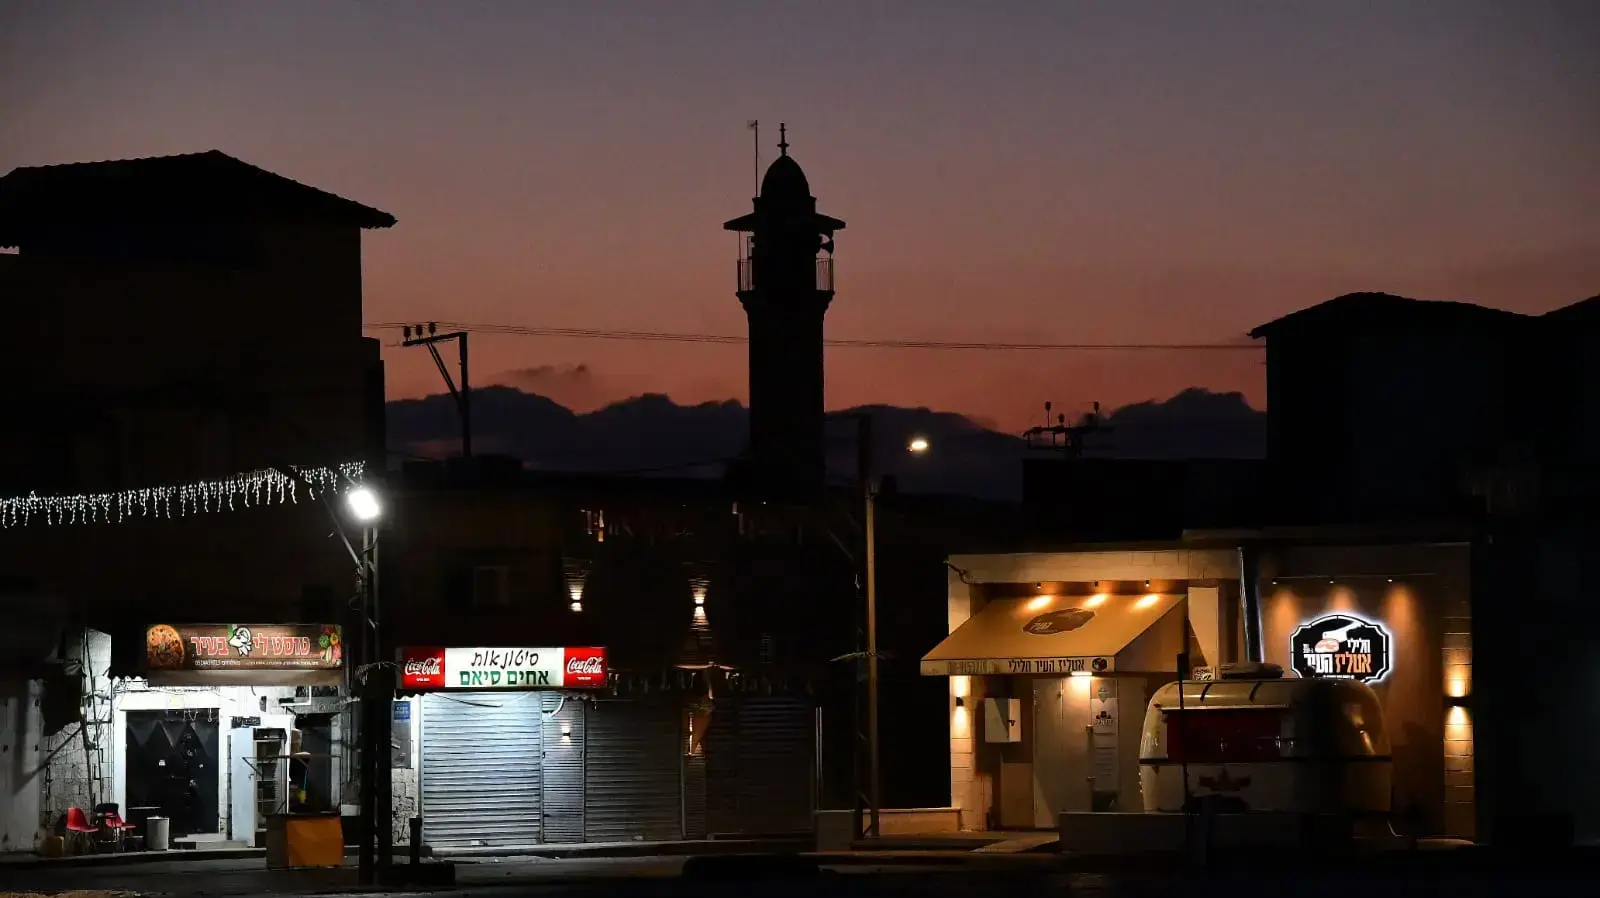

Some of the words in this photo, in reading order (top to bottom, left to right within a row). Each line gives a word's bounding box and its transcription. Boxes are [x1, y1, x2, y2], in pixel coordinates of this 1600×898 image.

[191, 636, 229, 656] בעיר
[252, 633, 269, 655] לי
[271, 636, 311, 655] טוסט
[1347, 637, 1371, 653] חלילי
[404, 657, 442, 676] Coca-Cola
[471, 649, 540, 669] סיטונאות
[566, 656, 605, 675] Coca-Cola
[1008, 658, 1032, 673] חלילי
[1035, 660, 1055, 673] העיר
[1058, 658, 1085, 672] אטליז
[1303, 653, 1333, 674] העיר
[1334, 651, 1373, 674] אטליז
[459, 670, 501, 686] סיאם
[507, 670, 550, 686] אחים
